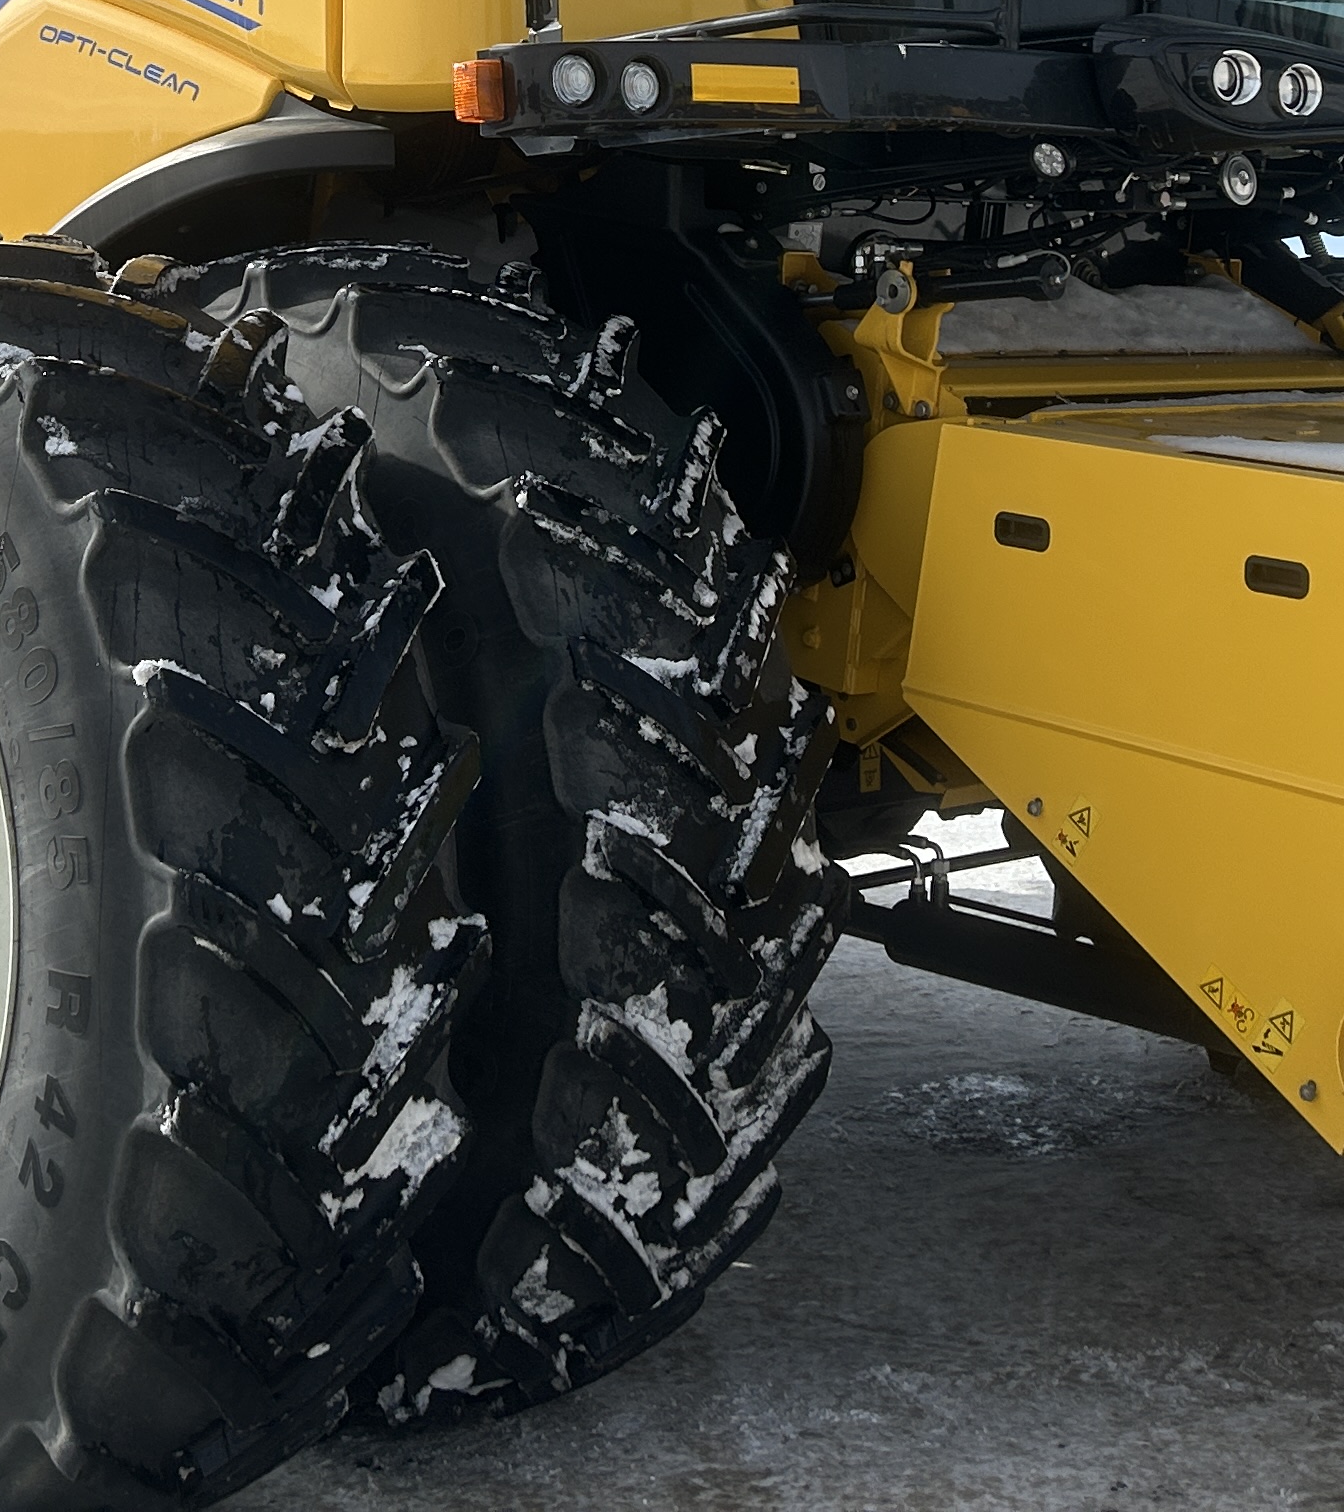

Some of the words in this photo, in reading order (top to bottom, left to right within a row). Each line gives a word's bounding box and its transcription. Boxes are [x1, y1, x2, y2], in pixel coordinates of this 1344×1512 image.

[39, 23, 200, 101] OPTI-CLEAN
[45, 969, 92, 1038] R
[18, 1073, 77, 1209] 42
